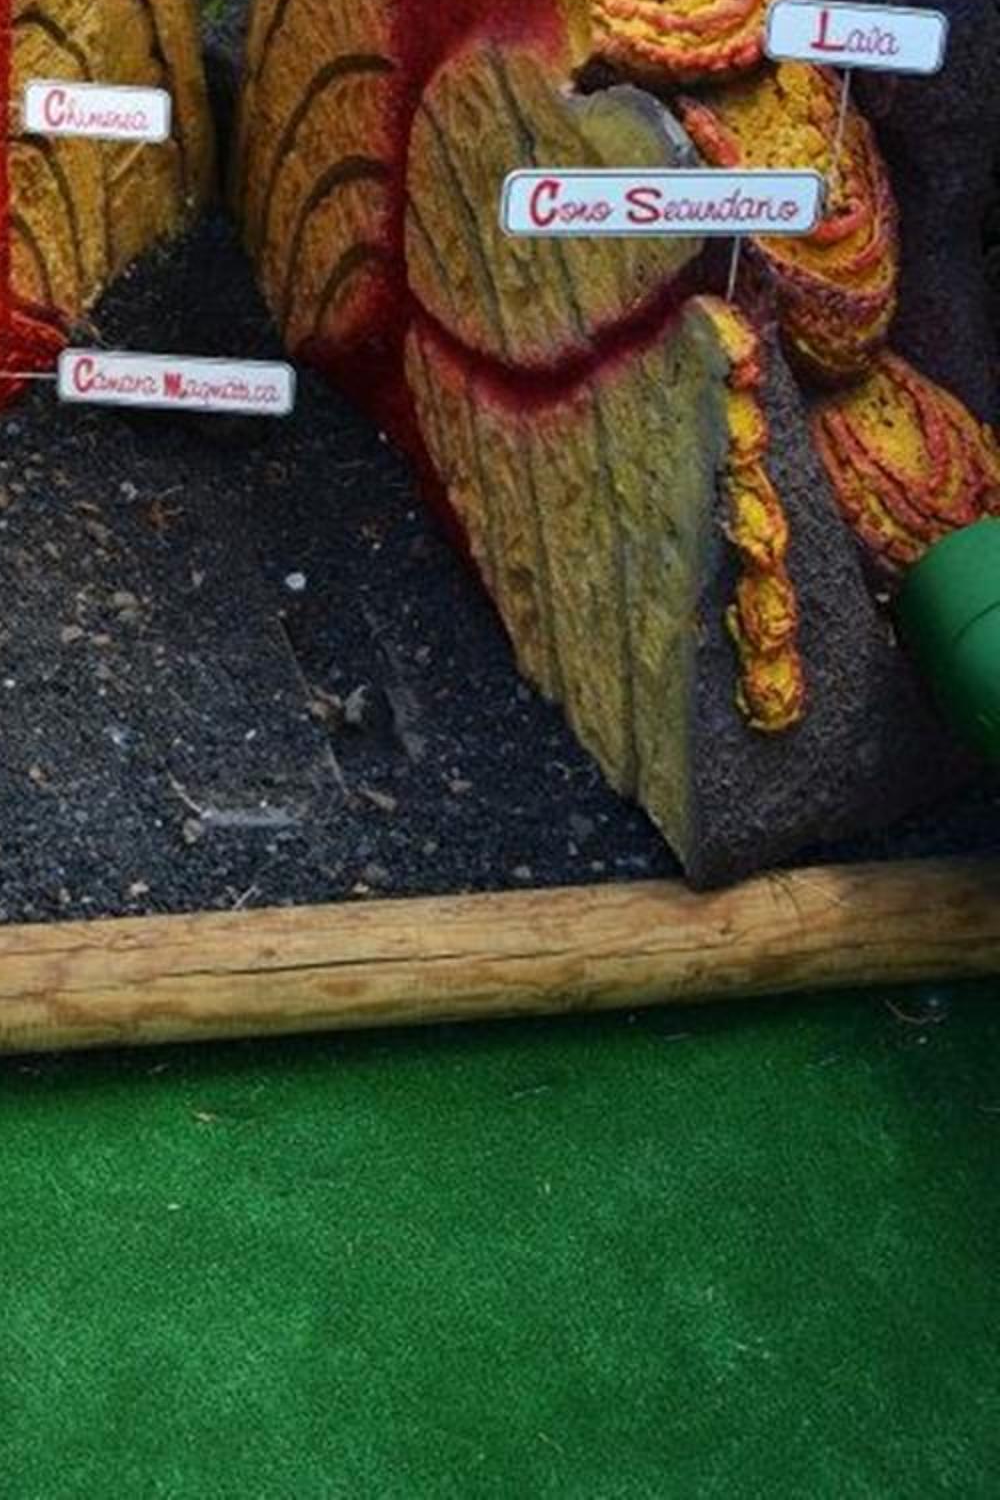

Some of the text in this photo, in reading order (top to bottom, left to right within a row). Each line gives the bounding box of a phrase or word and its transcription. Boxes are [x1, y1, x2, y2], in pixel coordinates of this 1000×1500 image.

[811, 10, 899, 55] Lava
[530, 179, 799, 228] Cono Secundario
